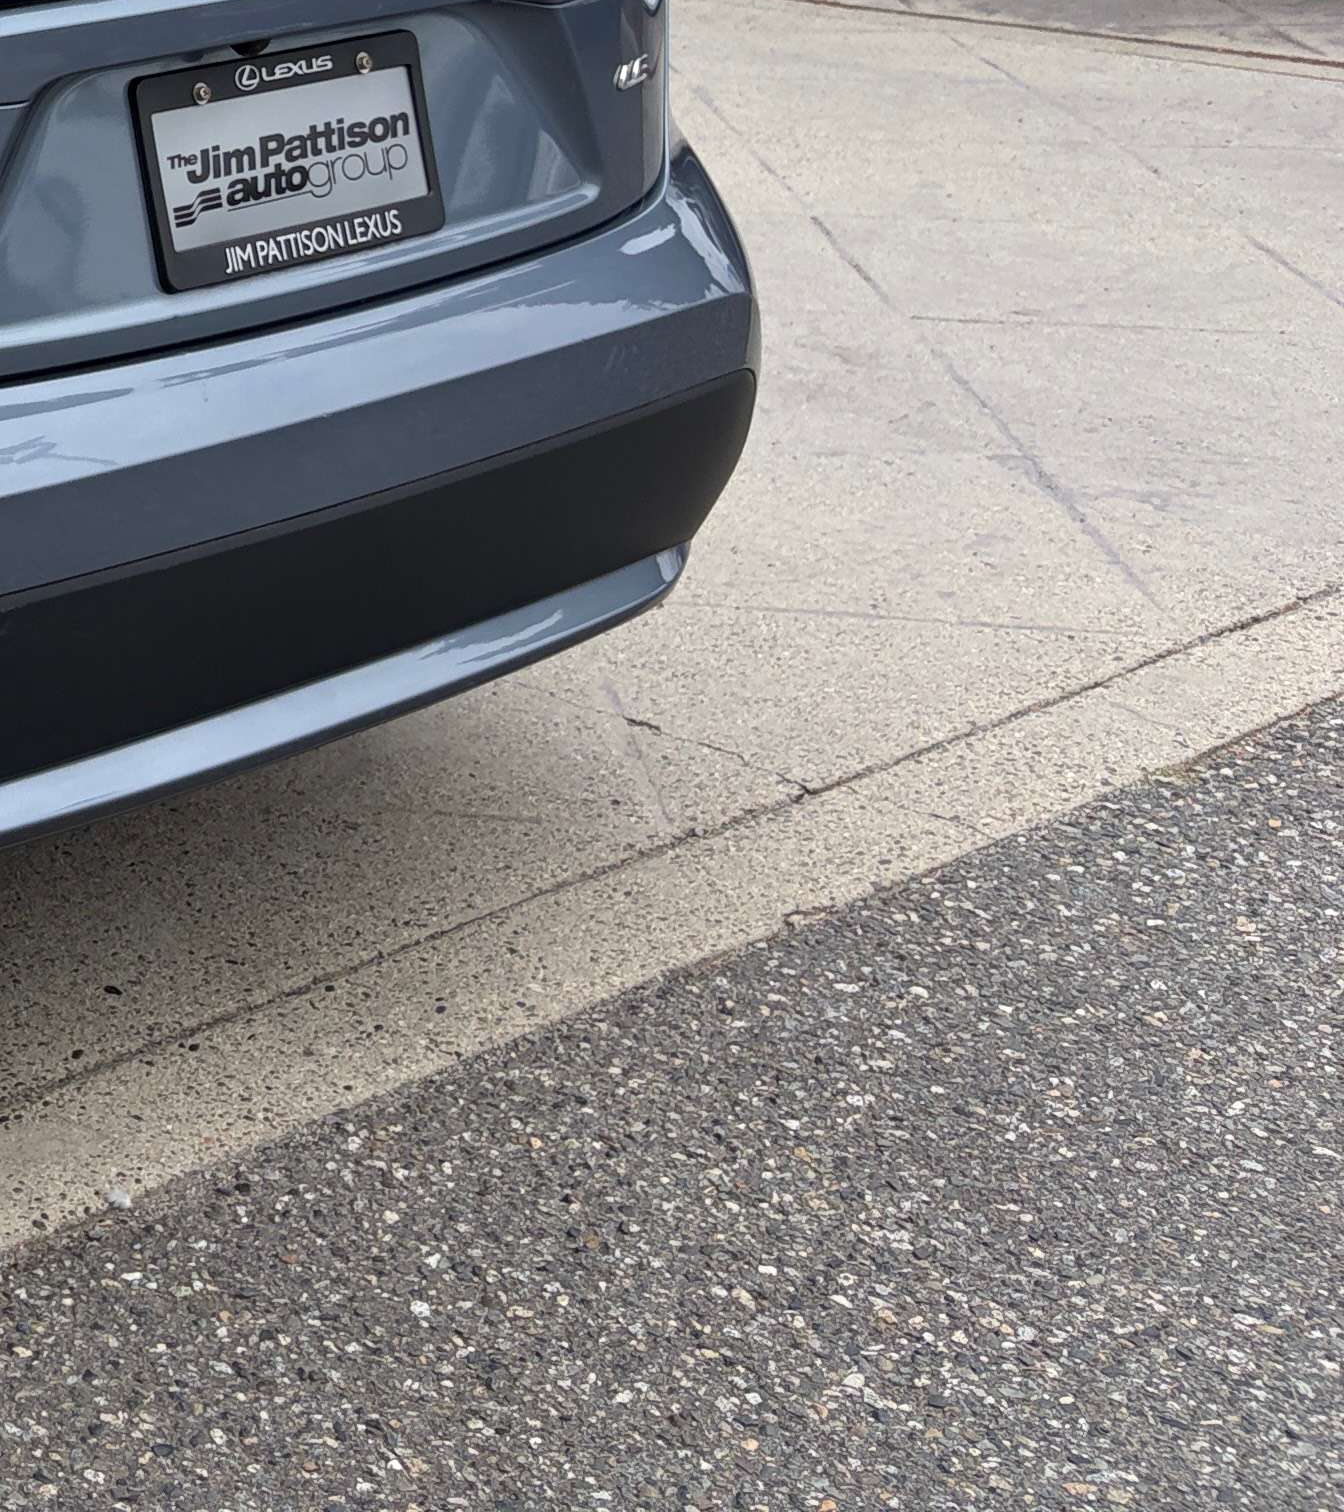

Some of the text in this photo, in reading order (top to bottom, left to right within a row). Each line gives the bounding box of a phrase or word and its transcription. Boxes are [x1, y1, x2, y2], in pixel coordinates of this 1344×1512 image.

[261, 55, 333, 82] LEXUS
[612, 53, 649, 91] LE
[167, 111, 411, 185] The Jim Pattison
[224, 208, 403, 275] JIM PATTISON LEXUS
